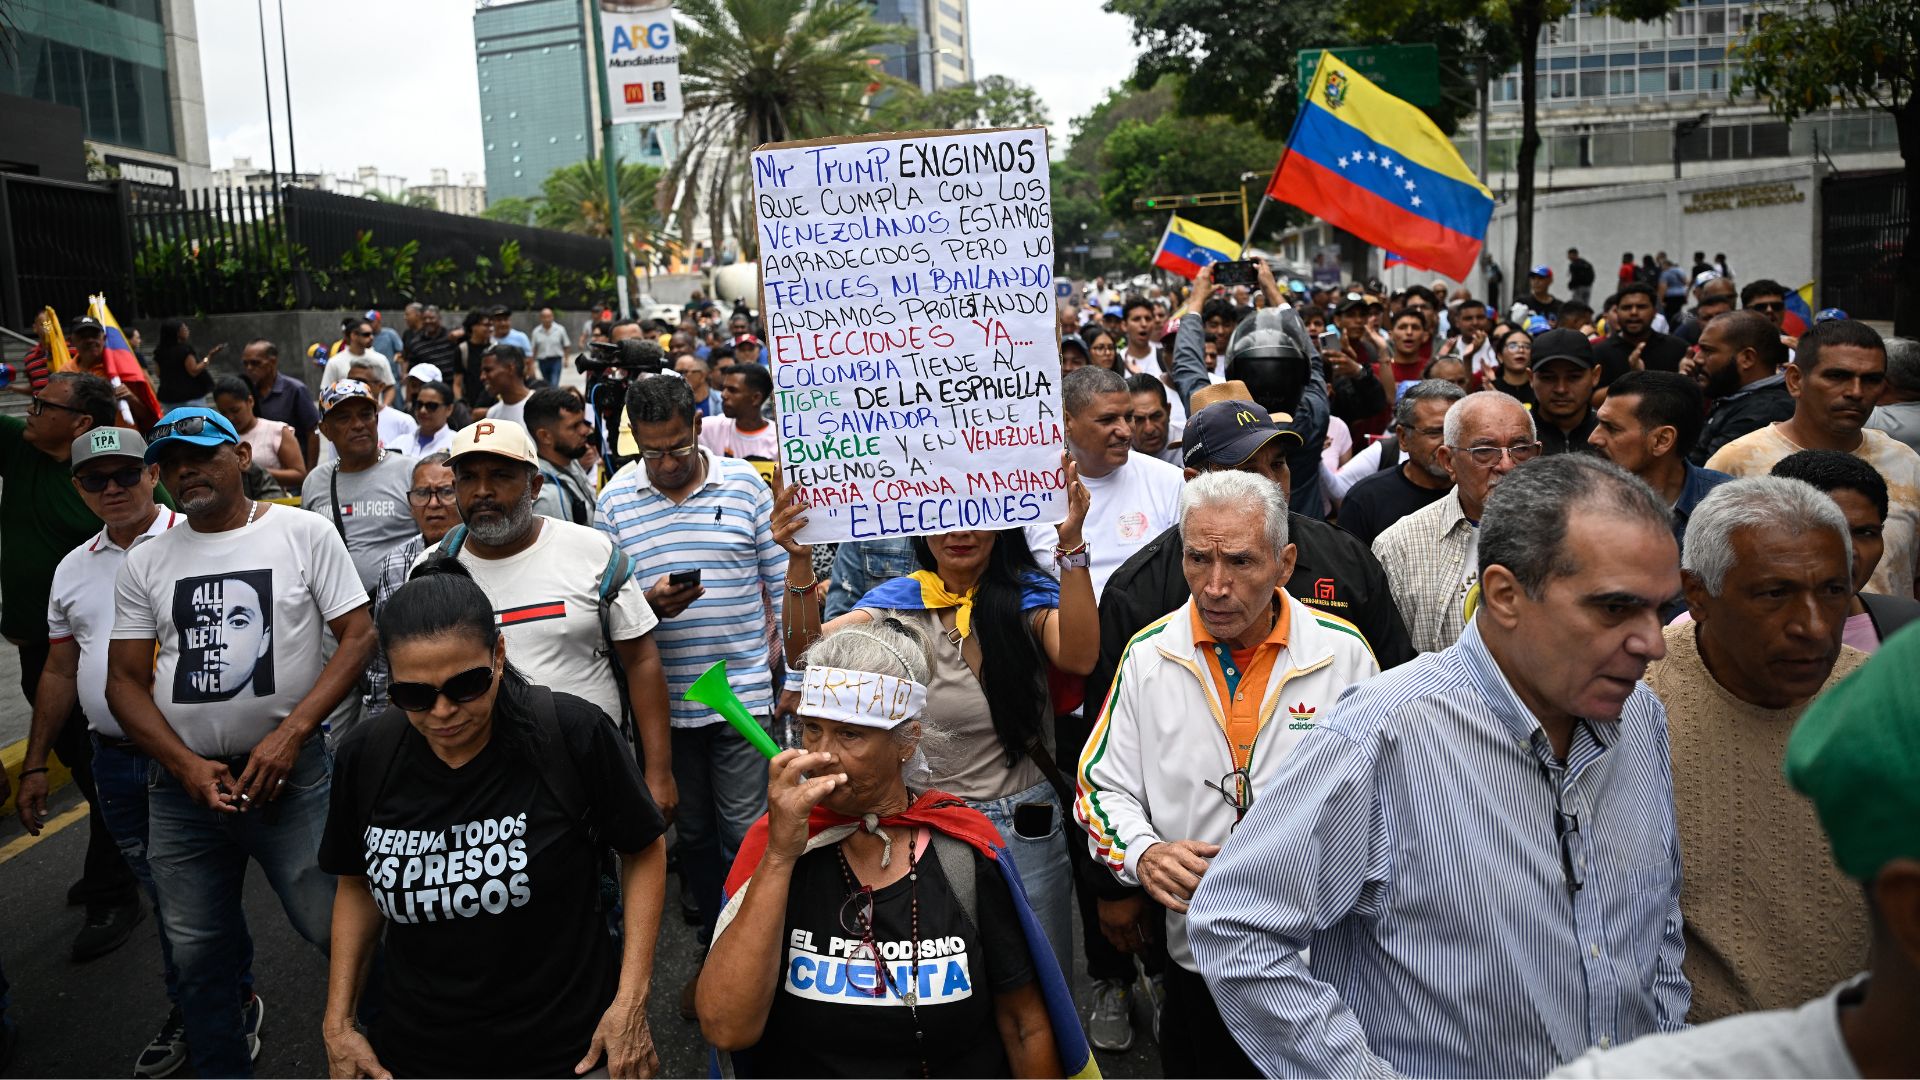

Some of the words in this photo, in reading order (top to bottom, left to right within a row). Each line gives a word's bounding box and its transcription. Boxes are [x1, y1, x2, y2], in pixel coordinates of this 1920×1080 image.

[612, 23, 669, 54] ARG
[755, 154, 794, 188] Mr
[899, 139, 1035, 177] EXIGIMOS
[759, 193, 809, 219] QUE
[820, 183, 924, 216] CUMPLA
[939, 180, 983, 202] CON
[999, 173, 1045, 201] LOS
[959, 203, 1050, 235] ESTAMOS
[941, 238, 1008, 262] PERO
[1024, 235, 1051, 259] NO
[892, 272, 919, 298] NI
[930, 264, 1050, 293] BAILANDO
[772, 303, 896, 336] ANDAMOS
[899, 292, 1048, 323] PROTESTANDO
[775, 324, 954, 363] ELECCIONES
[777, 358, 901, 389] COLOMBIA
[902, 352, 978, 379] TIENE
[993, 344, 1026, 372] AL
[775, 389, 841, 413] TIGRE
[854, 387, 889, 410] DE
[899, 380, 933, 406] LA
[939, 370, 1051, 403] ESPRIELLA
[473, 422, 495, 443] P
[783, 415, 811, 439] EL
[818, 407, 939, 435] SALVADOR
[942, 403, 1019, 429] TIENE
[1038, 400, 1054, 421] A
[94, 435, 115, 447] TPA
[784, 434, 881, 464] BUKELE
[895, 435, 909, 464] Y
[924, 430, 957, 452] EN
[961, 421, 1063, 453] VENEZUELA
[784, 459, 896, 487] TENEMOS
[873, 476, 956, 503] CORINA
[966, 467, 1067, 494] MACHADO
[352, 500, 395, 517] HILFIGER
[192, 582, 223, 606] ALL
[203, 649, 220, 671] IS
[801, 668, 912, 720] ERTAD
[452, 812, 527, 849] TODOS
[403, 838, 528, 889] PRESOS
[369, 872, 531, 924] OLITICOS
[790, 928, 817, 952] EL
[829, 936, 966, 960] PERIODISMO
[790, 956, 972, 999] CUENTA
